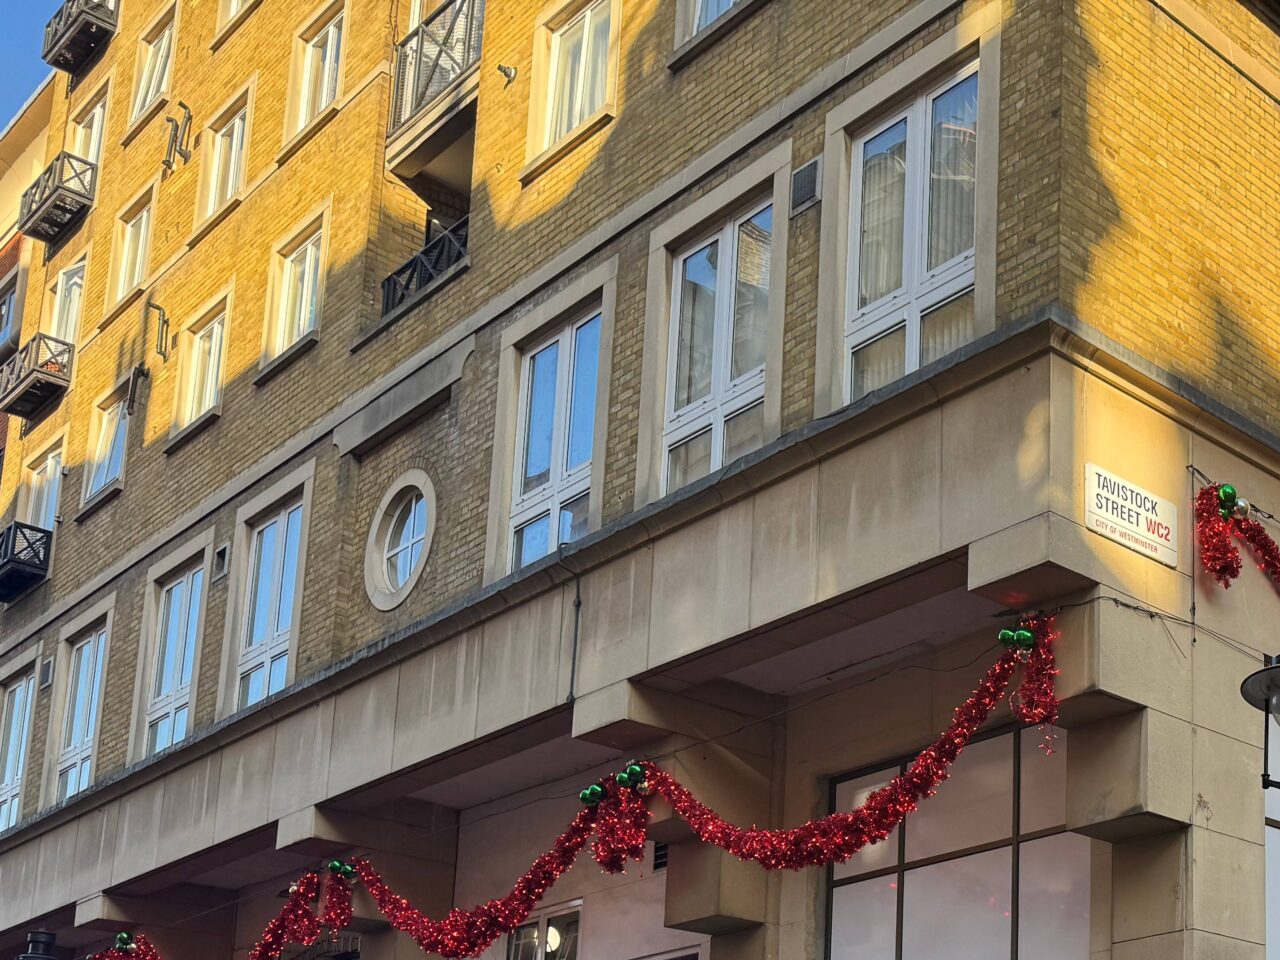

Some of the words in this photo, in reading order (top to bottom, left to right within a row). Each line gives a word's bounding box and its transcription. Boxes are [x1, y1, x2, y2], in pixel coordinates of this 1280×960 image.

[1095, 472, 1158, 517] TAVISTOCK
[1095, 493, 1142, 527] STREET
[1145, 516, 1171, 542] WC2
[1095, 519, 1108, 530] CITY
[1109, 524, 1117, 535] OF
[1119, 530, 1158, 554] WESTMINSTER
